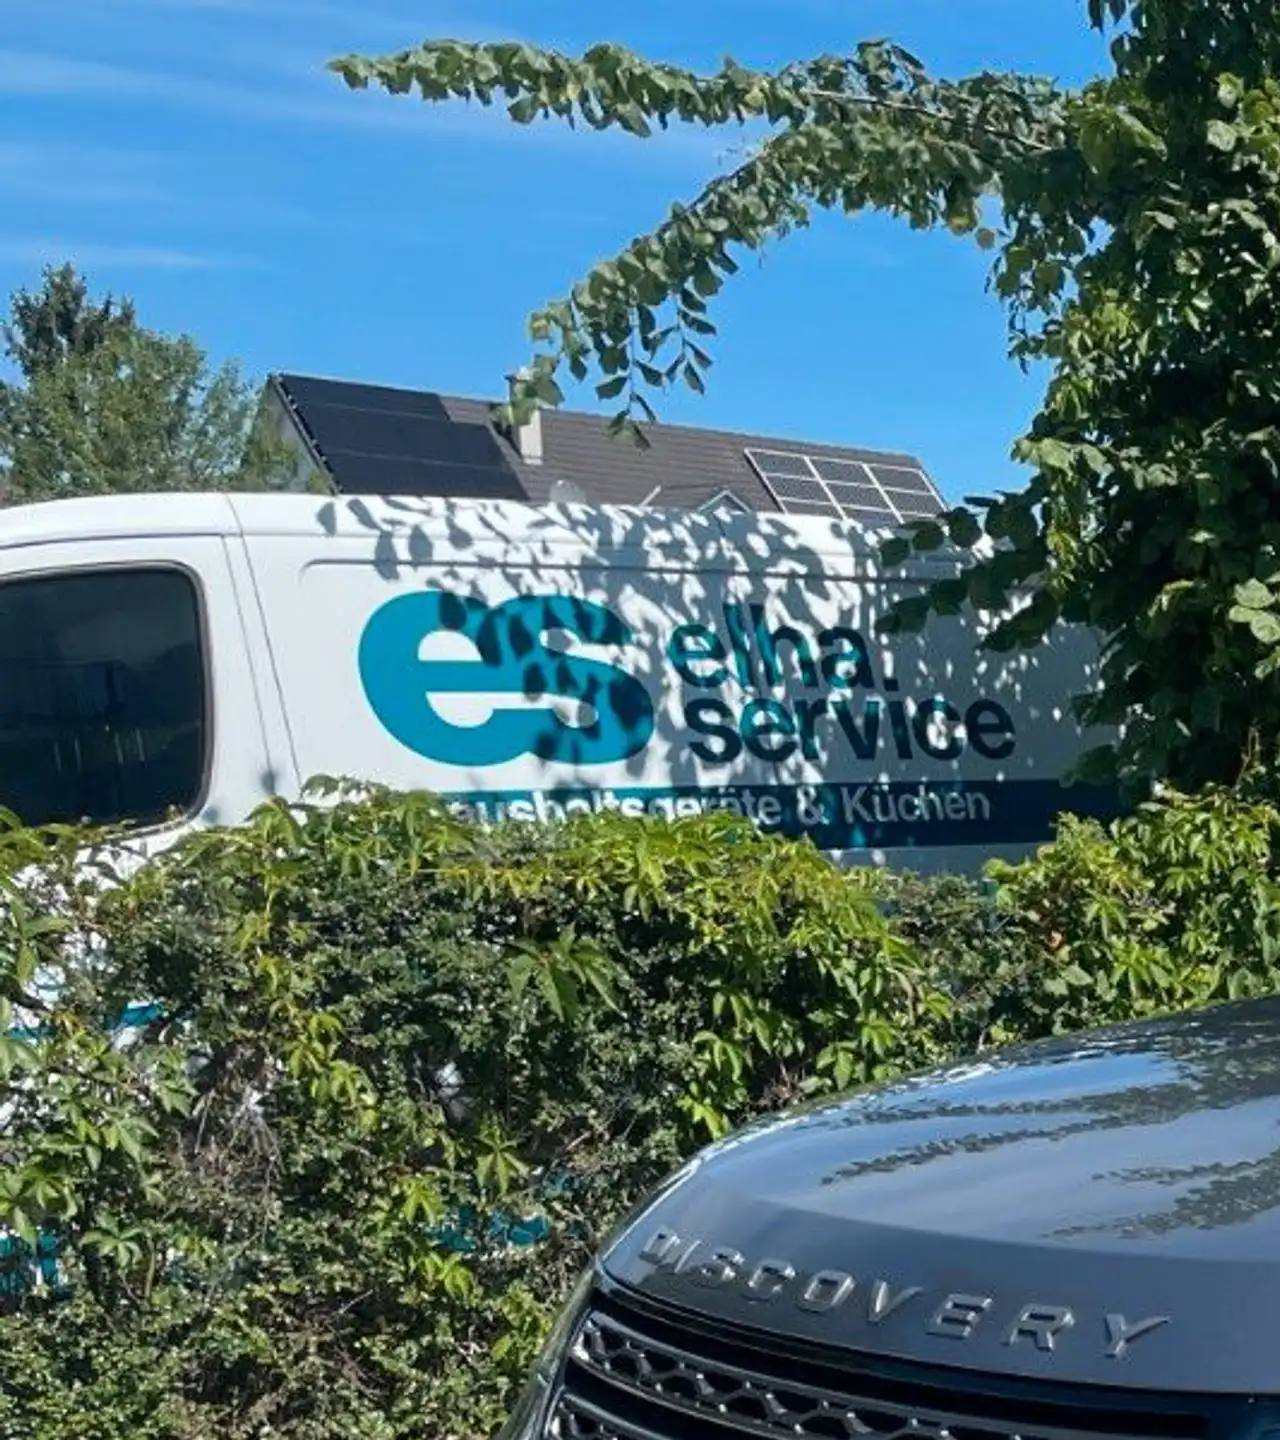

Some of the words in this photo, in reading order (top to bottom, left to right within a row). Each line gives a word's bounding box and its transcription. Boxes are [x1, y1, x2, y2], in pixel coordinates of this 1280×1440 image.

[357, 590, 654, 768] es
[684, 698, 1016, 763] service
[443, 786, 782, 827] aushaltsgeräte
[796, 783, 829, 826] &
[840, 783, 990, 824] Küchen
[639, 1226, 1171, 1358] DISCOVERY
